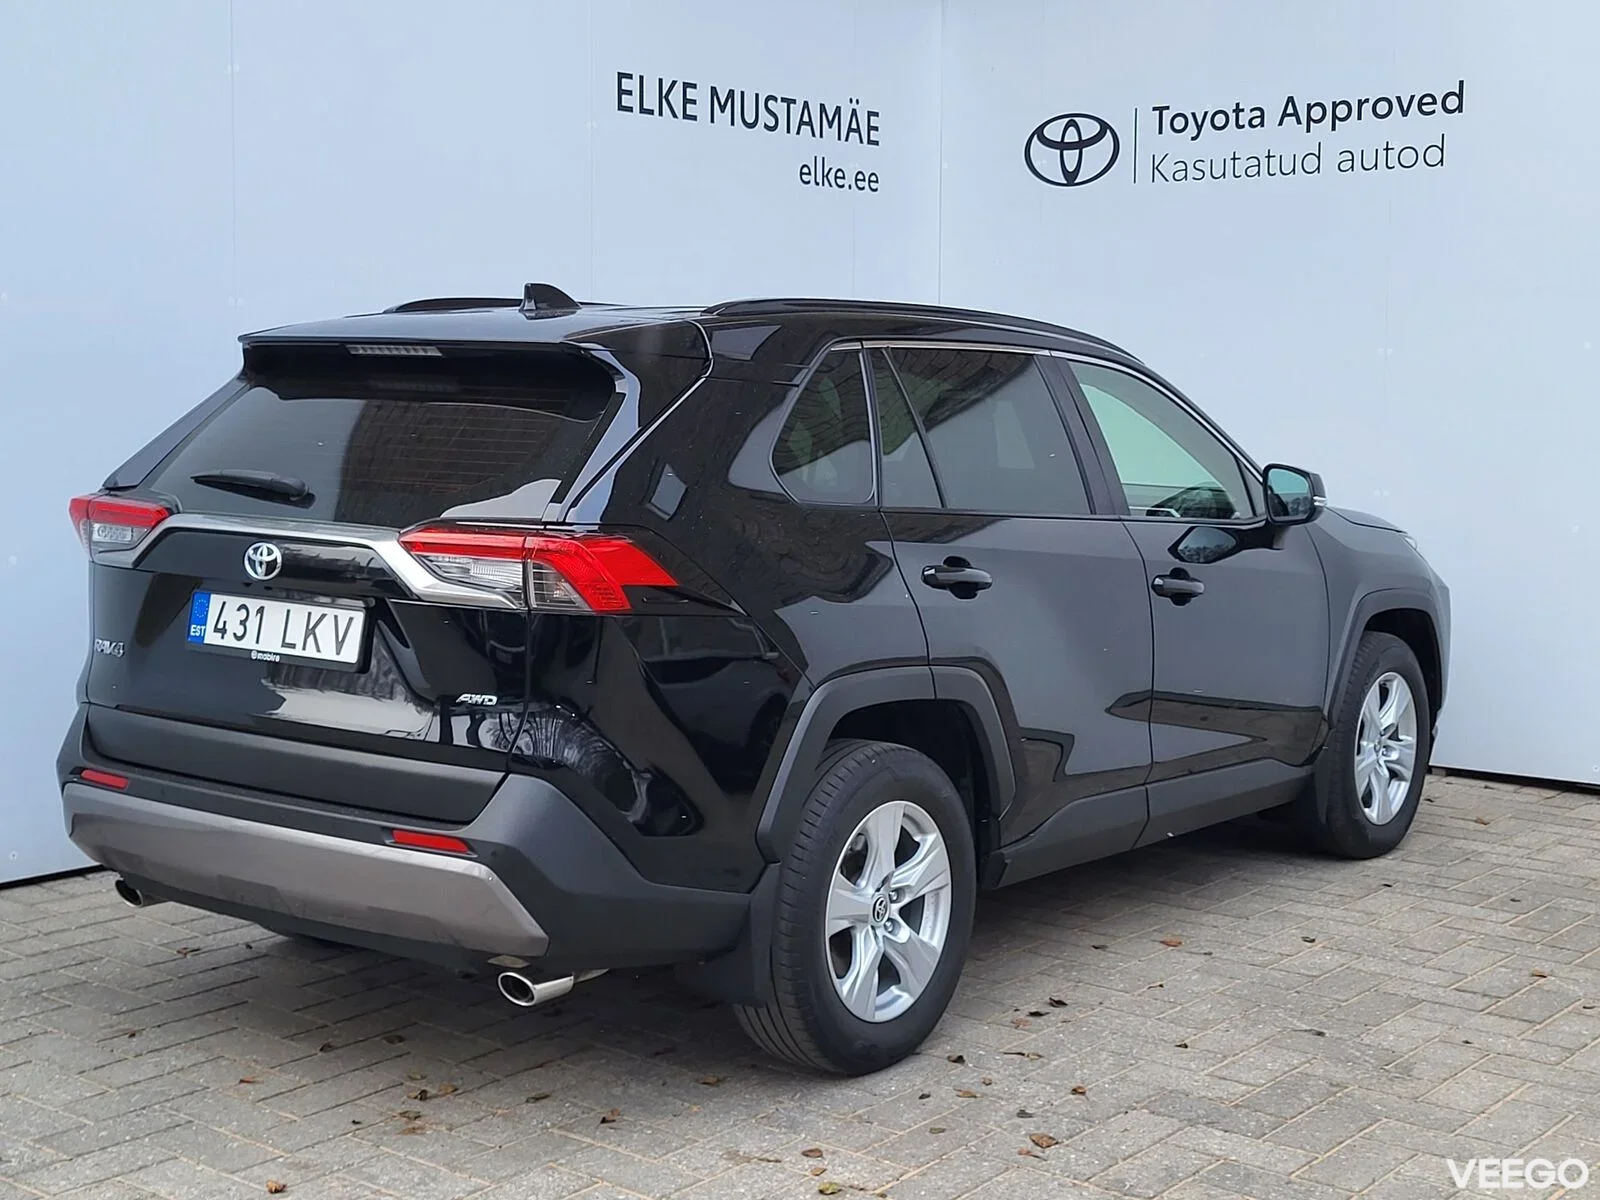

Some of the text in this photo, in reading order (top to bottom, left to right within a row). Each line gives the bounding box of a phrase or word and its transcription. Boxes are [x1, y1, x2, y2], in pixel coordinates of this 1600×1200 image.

[617, 71, 880, 146] ELKE MUSTAMÄE
[1152, 80, 1465, 141] Toyota Approved
[799, 155, 879, 192] elke.ee
[1151, 134, 1446, 183] Kasutatud autod
[95, 638, 125, 658] RAV4
[190, 624, 206, 637] EST
[212, 600, 355, 656] 431 LKV
[455, 693, 498, 706] AWD
